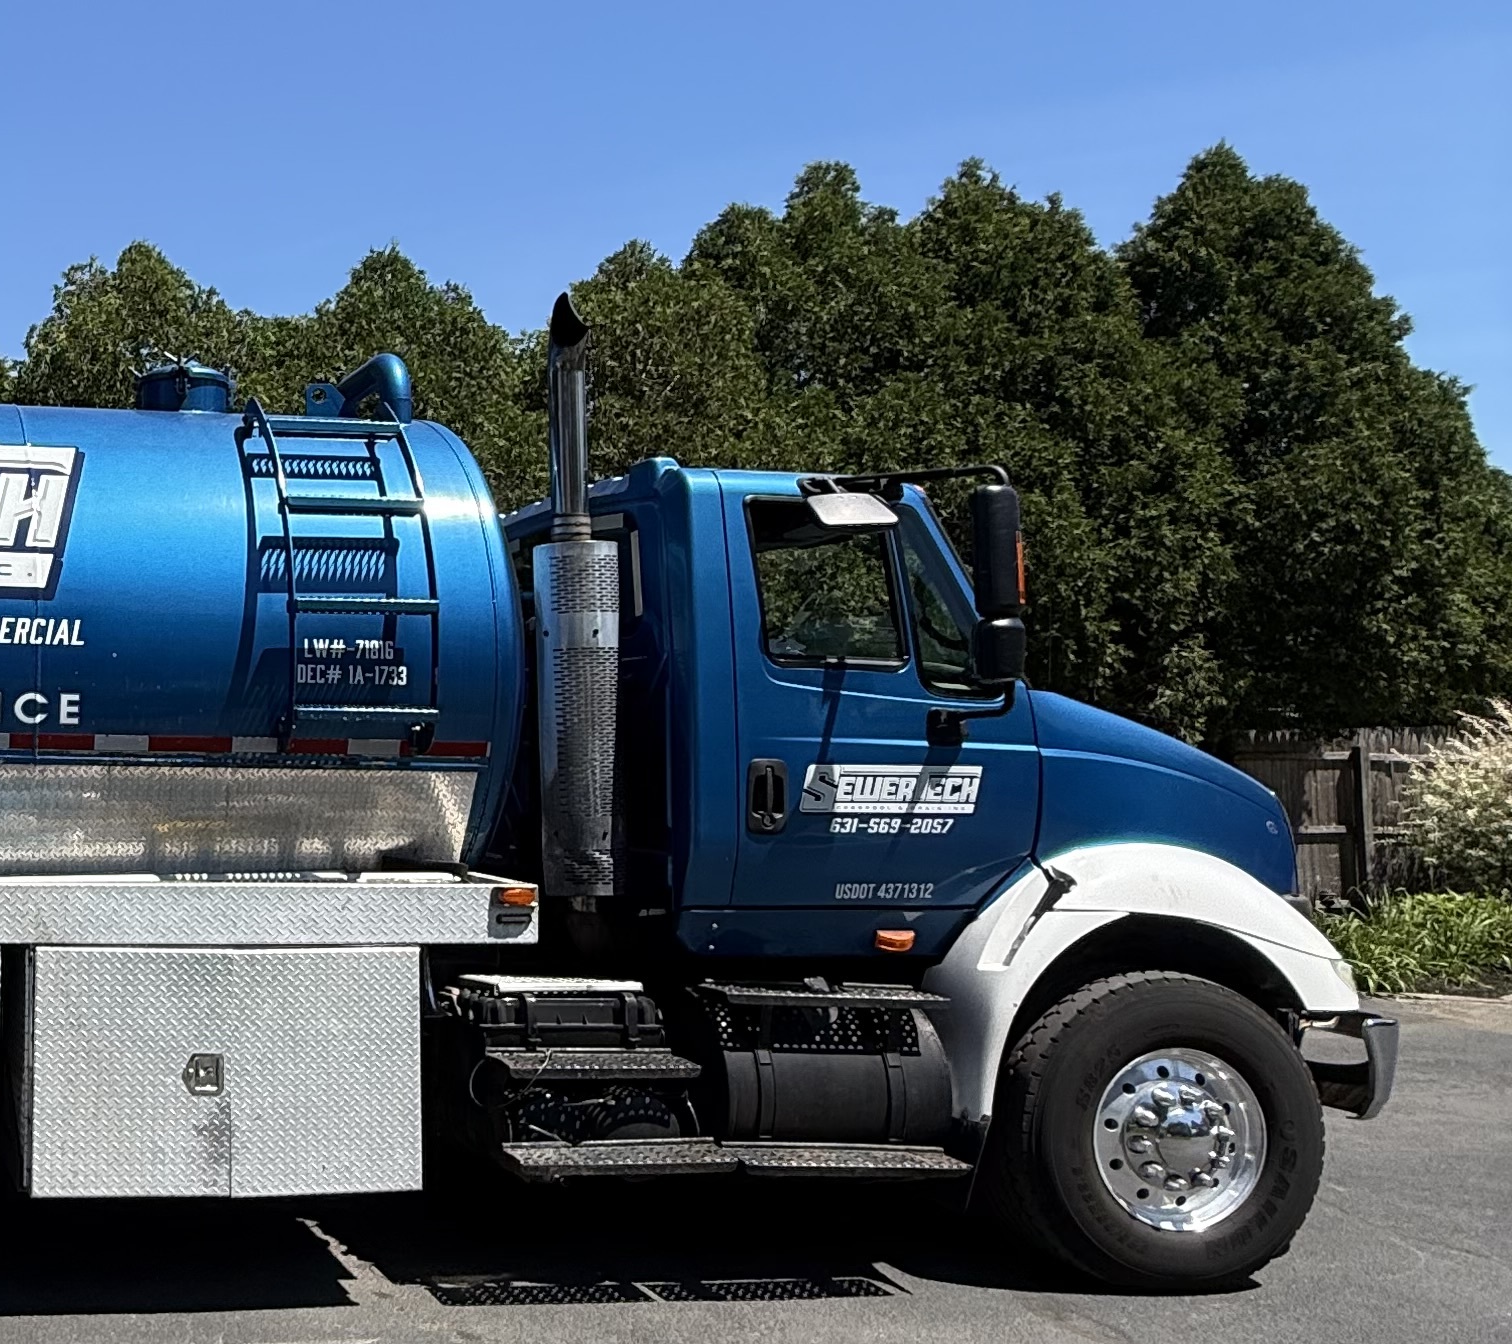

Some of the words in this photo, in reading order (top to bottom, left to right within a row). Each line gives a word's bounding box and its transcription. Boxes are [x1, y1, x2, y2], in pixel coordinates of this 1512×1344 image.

[297, 664, 342, 685] DEC#
[348, 665, 407, 686] 1A-1733
[829, 817, 954, 834] 631-569-2057
[834, 883, 876, 900] USDOT
[877, 882, 934, 899] 4371312
